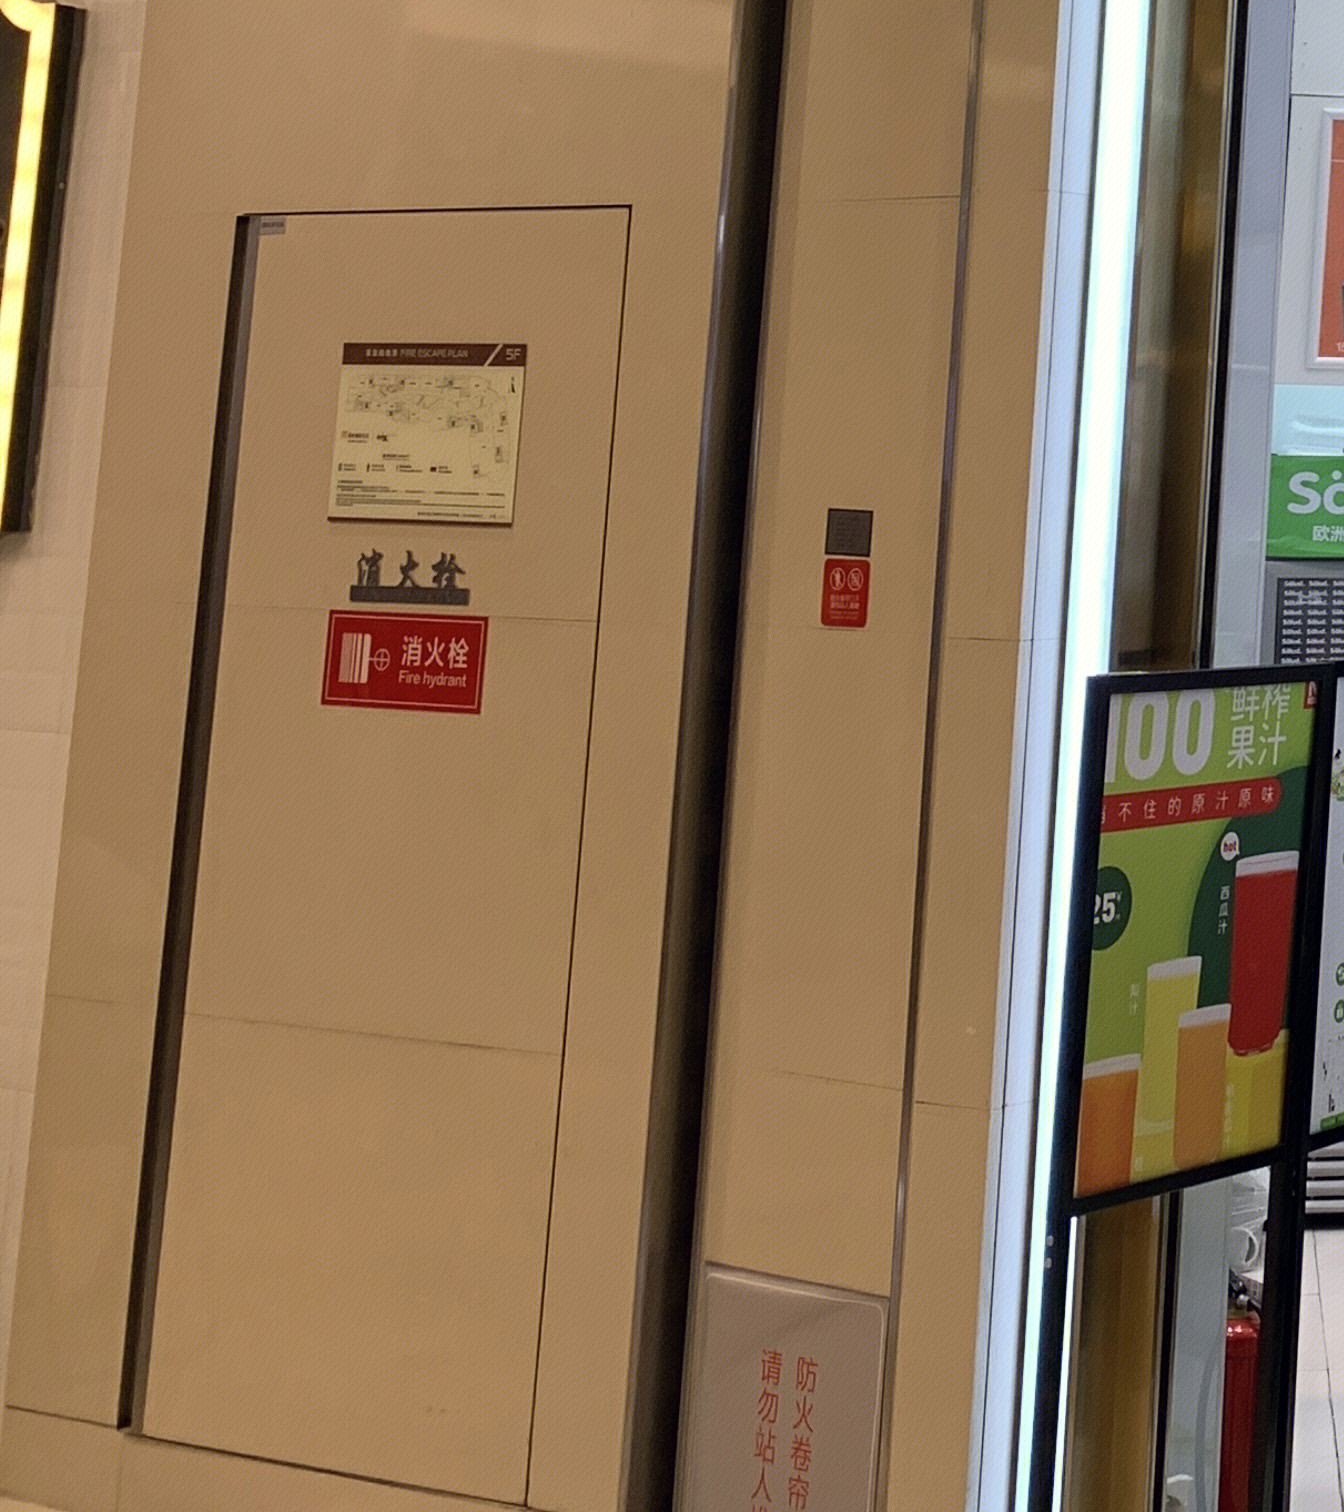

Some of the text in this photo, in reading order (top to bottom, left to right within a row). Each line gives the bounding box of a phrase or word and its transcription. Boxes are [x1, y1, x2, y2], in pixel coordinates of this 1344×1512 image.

[505, 347, 521, 361] 5F
[401, 635, 470, 669] 消火栓
[398, 670, 467, 688] Fire hydrant
[1231, 685, 1291, 721] 鲜榨
[1227, 721, 1287, 769] 果汁
[1223, 841, 1237, 853] hot
[788, 1356, 819, 1511] 防火卷帘
